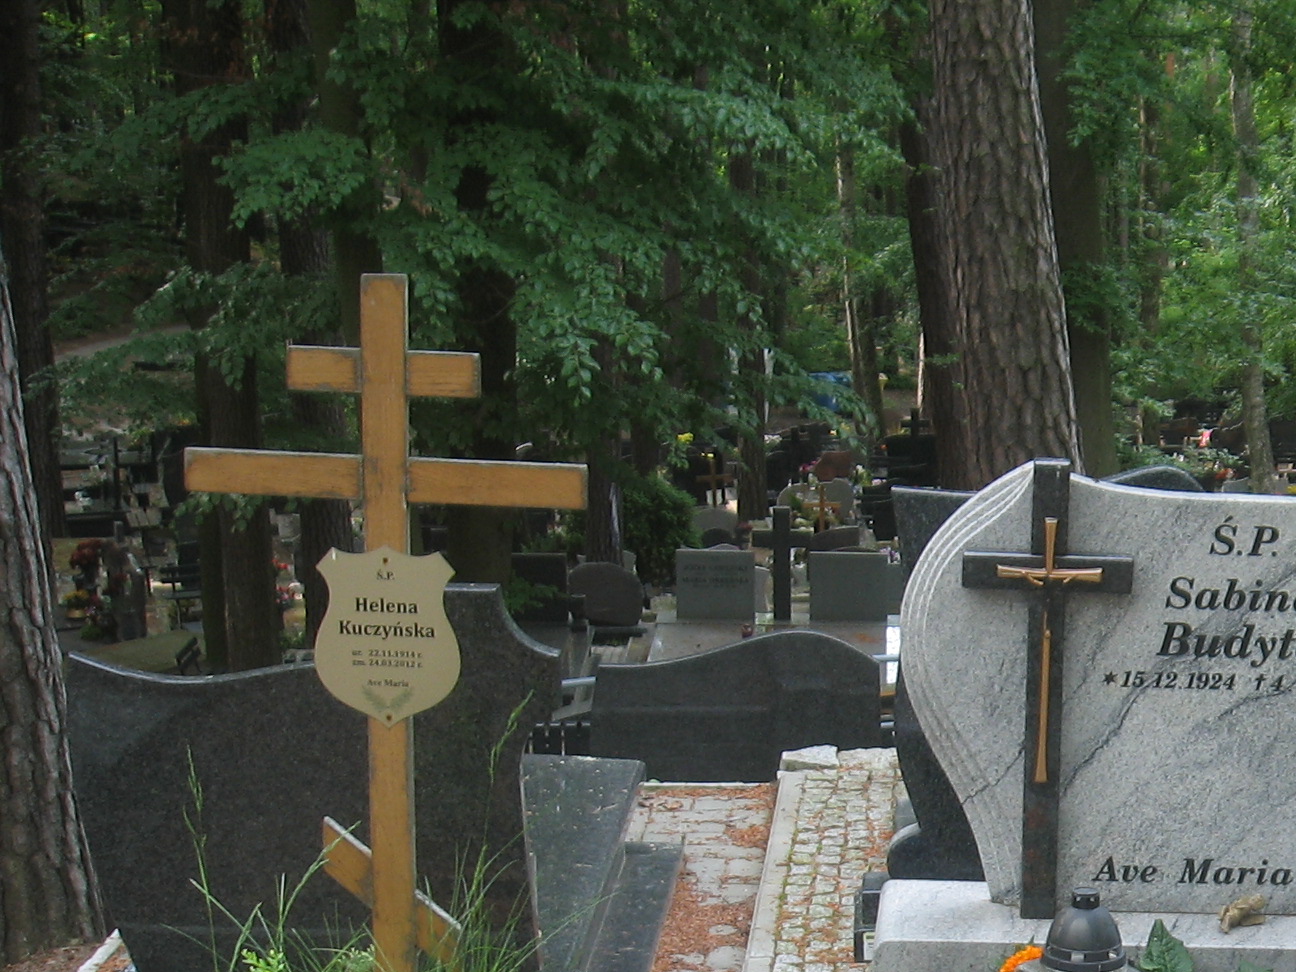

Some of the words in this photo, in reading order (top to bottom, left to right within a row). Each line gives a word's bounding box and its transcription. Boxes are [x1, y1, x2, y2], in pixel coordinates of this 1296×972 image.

[1209, 514, 1280, 556] Ś.P.
[355, 597, 418, 614] Helena
[339, 620, 435, 640] Kuczyńska
[384, 678, 409, 687] Maria
[1091, 855, 1158, 884] Ave
[1178, 858, 1295, 887] Maria
